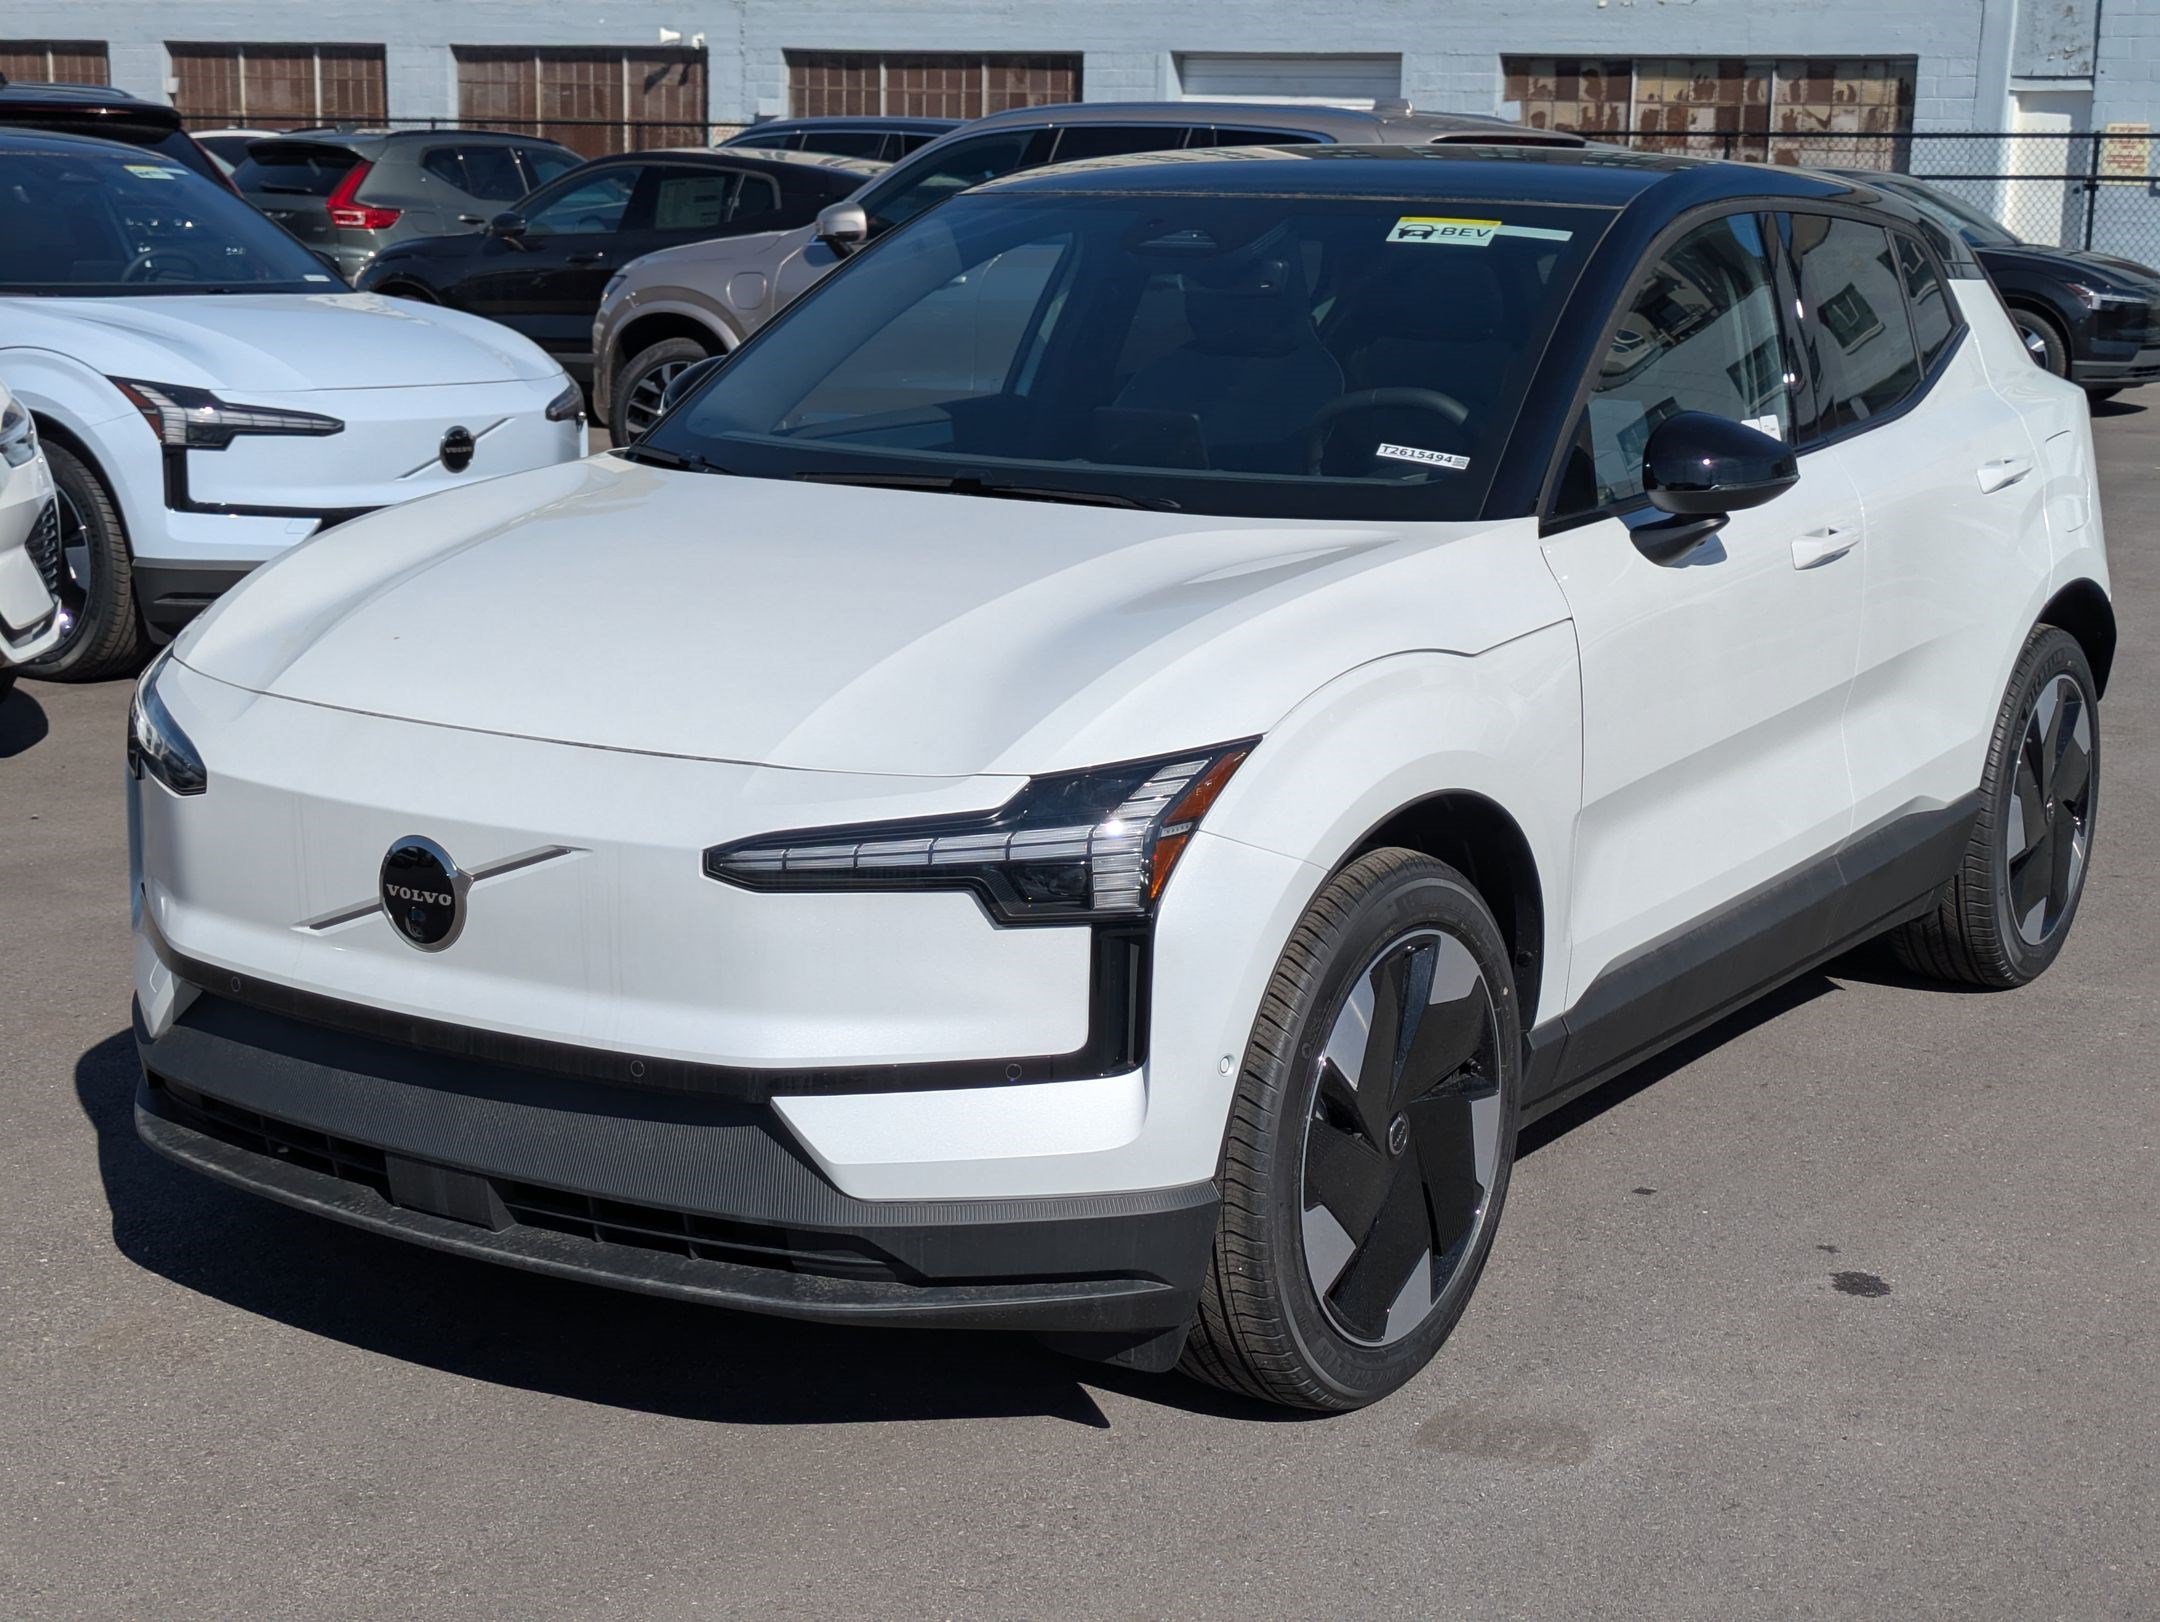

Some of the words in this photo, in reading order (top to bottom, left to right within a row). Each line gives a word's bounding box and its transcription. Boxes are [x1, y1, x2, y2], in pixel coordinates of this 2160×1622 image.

[1440, 227, 1491, 237] BEV
[1382, 445, 1453, 463] T2615494
[386, 883, 452, 906] VOLVO
